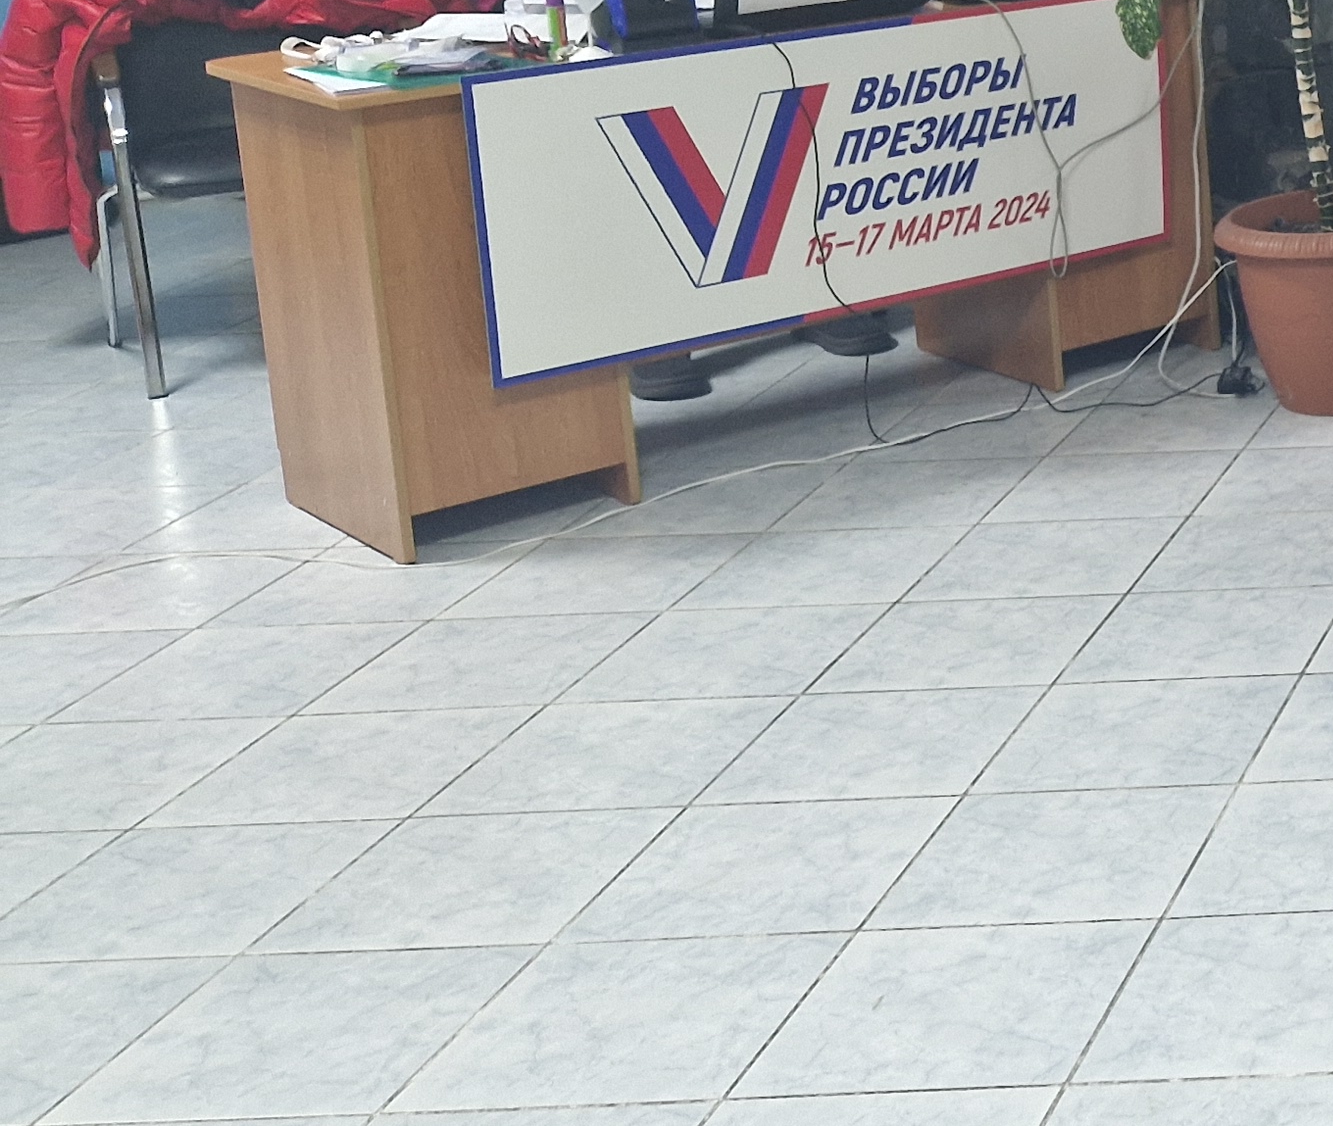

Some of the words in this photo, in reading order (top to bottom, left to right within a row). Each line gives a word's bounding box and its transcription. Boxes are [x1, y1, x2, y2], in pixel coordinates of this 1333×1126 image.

[850, 54, 1027, 114] ВЫБОРЫ
[833, 93, 1077, 167] ПРЕЗИДЕНТА
[816, 157, 979, 221] РОССИИ
[888, 202, 982, 250] МАРТА
[987, 189, 1051, 231] 2024
